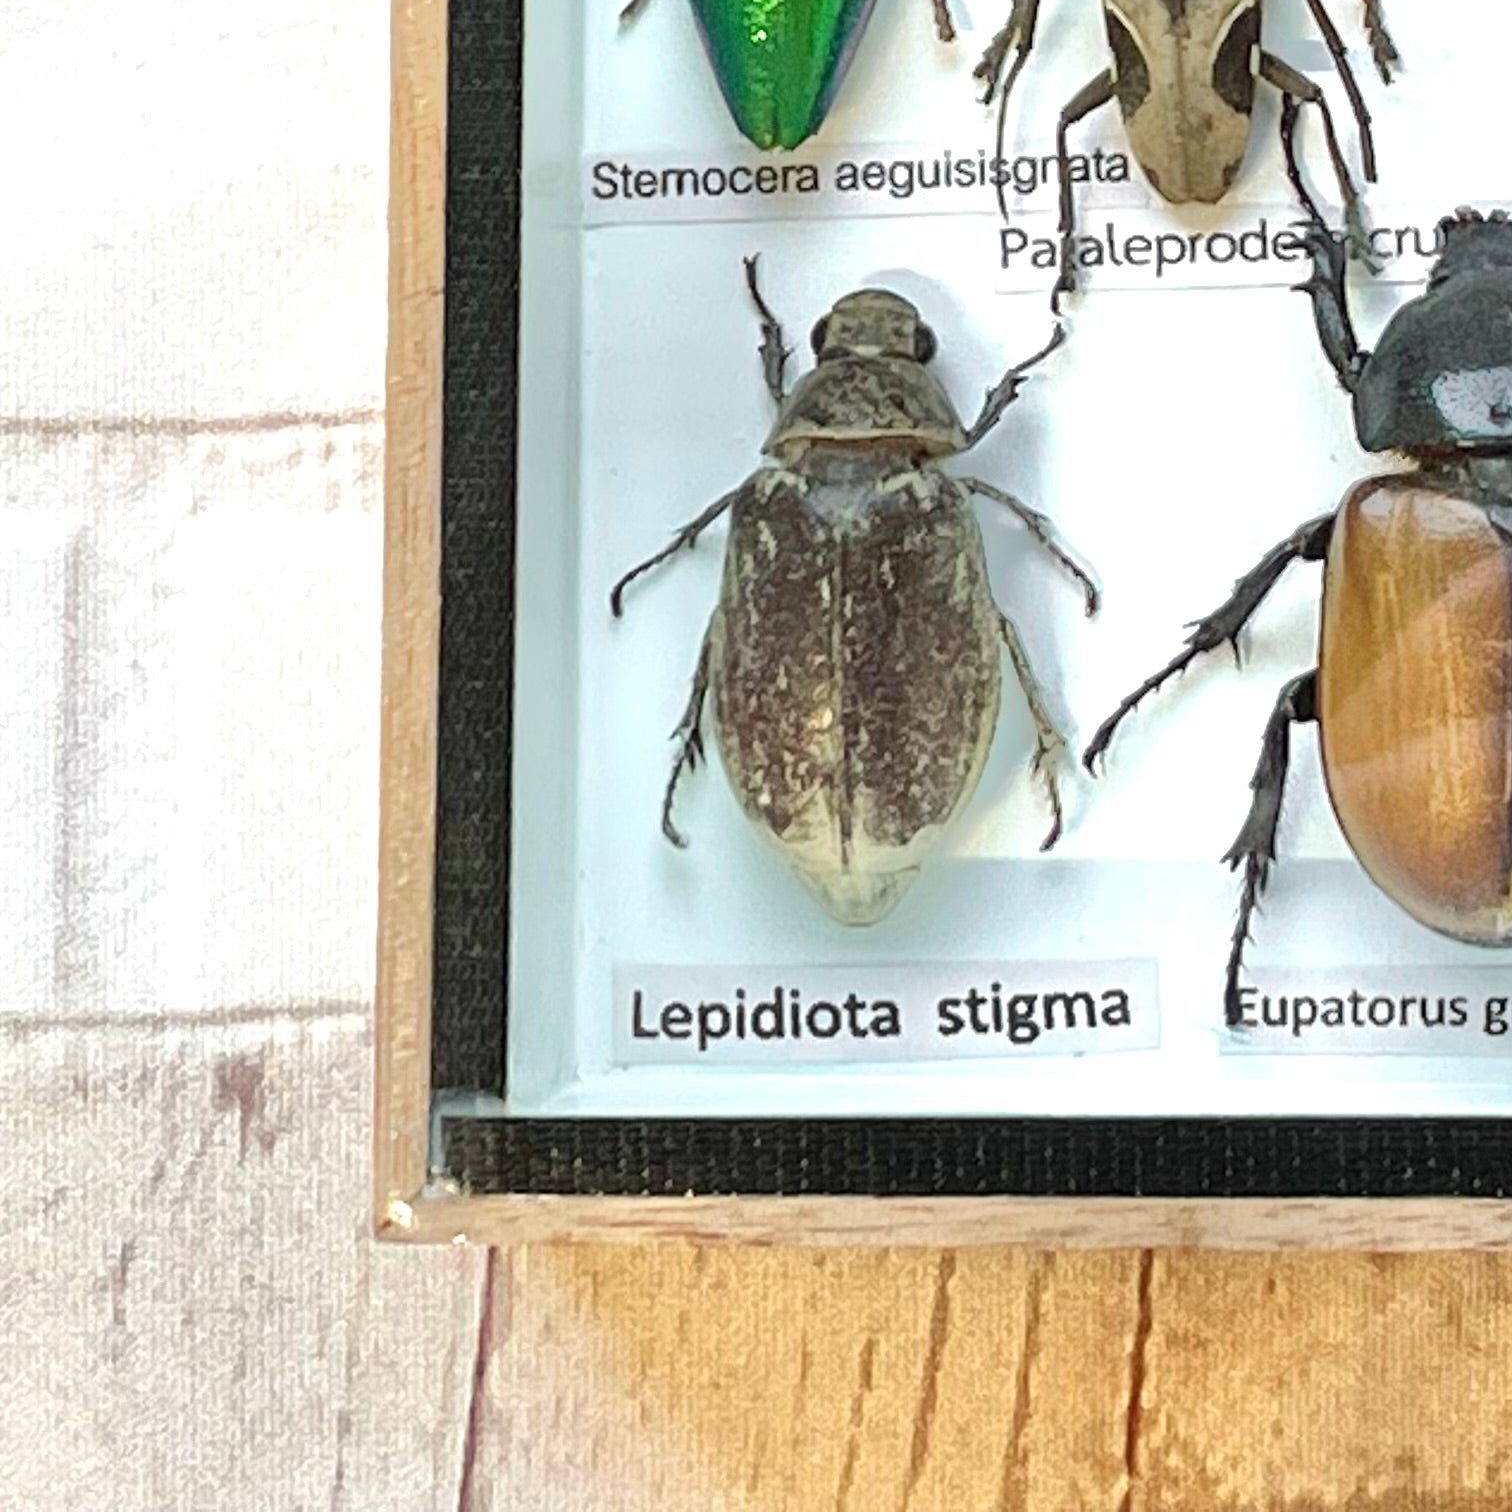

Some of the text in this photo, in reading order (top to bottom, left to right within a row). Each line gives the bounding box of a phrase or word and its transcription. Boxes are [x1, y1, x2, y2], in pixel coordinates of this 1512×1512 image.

[632, 980, 1132, 1052] Lepidiota stigma
[1234, 986, 1469, 1037] Eupatorus
